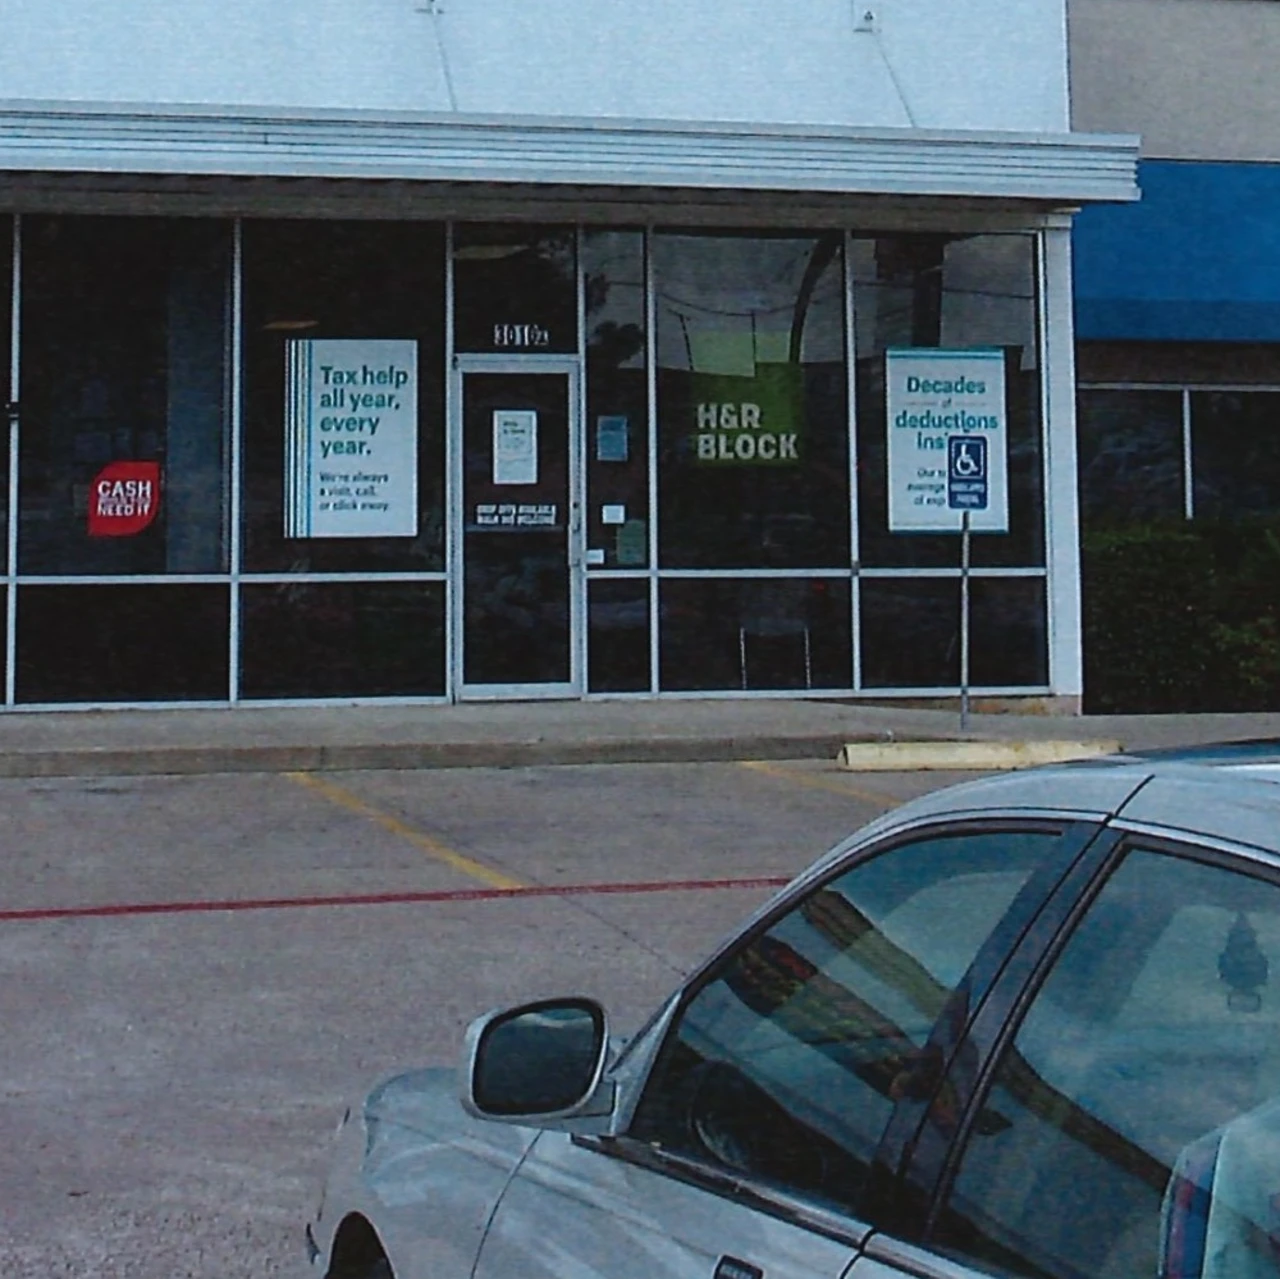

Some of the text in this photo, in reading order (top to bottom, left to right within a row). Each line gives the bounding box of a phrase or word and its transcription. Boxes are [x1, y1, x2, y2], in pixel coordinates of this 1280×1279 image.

[320, 365, 408, 389] Tax help
[907, 376, 986, 394] Decades
[320, 388, 401, 412] all year,
[941, 398, 952, 408] of
[698, 403, 761, 429] H&R
[895, 410, 999, 429] deductions
[320, 417, 380, 436] every
[320, 440, 372, 459] year.
[698, 433, 799, 459] BLOCK
[916, 431, 948, 450] ins
[97, 481, 152, 497] CASH
